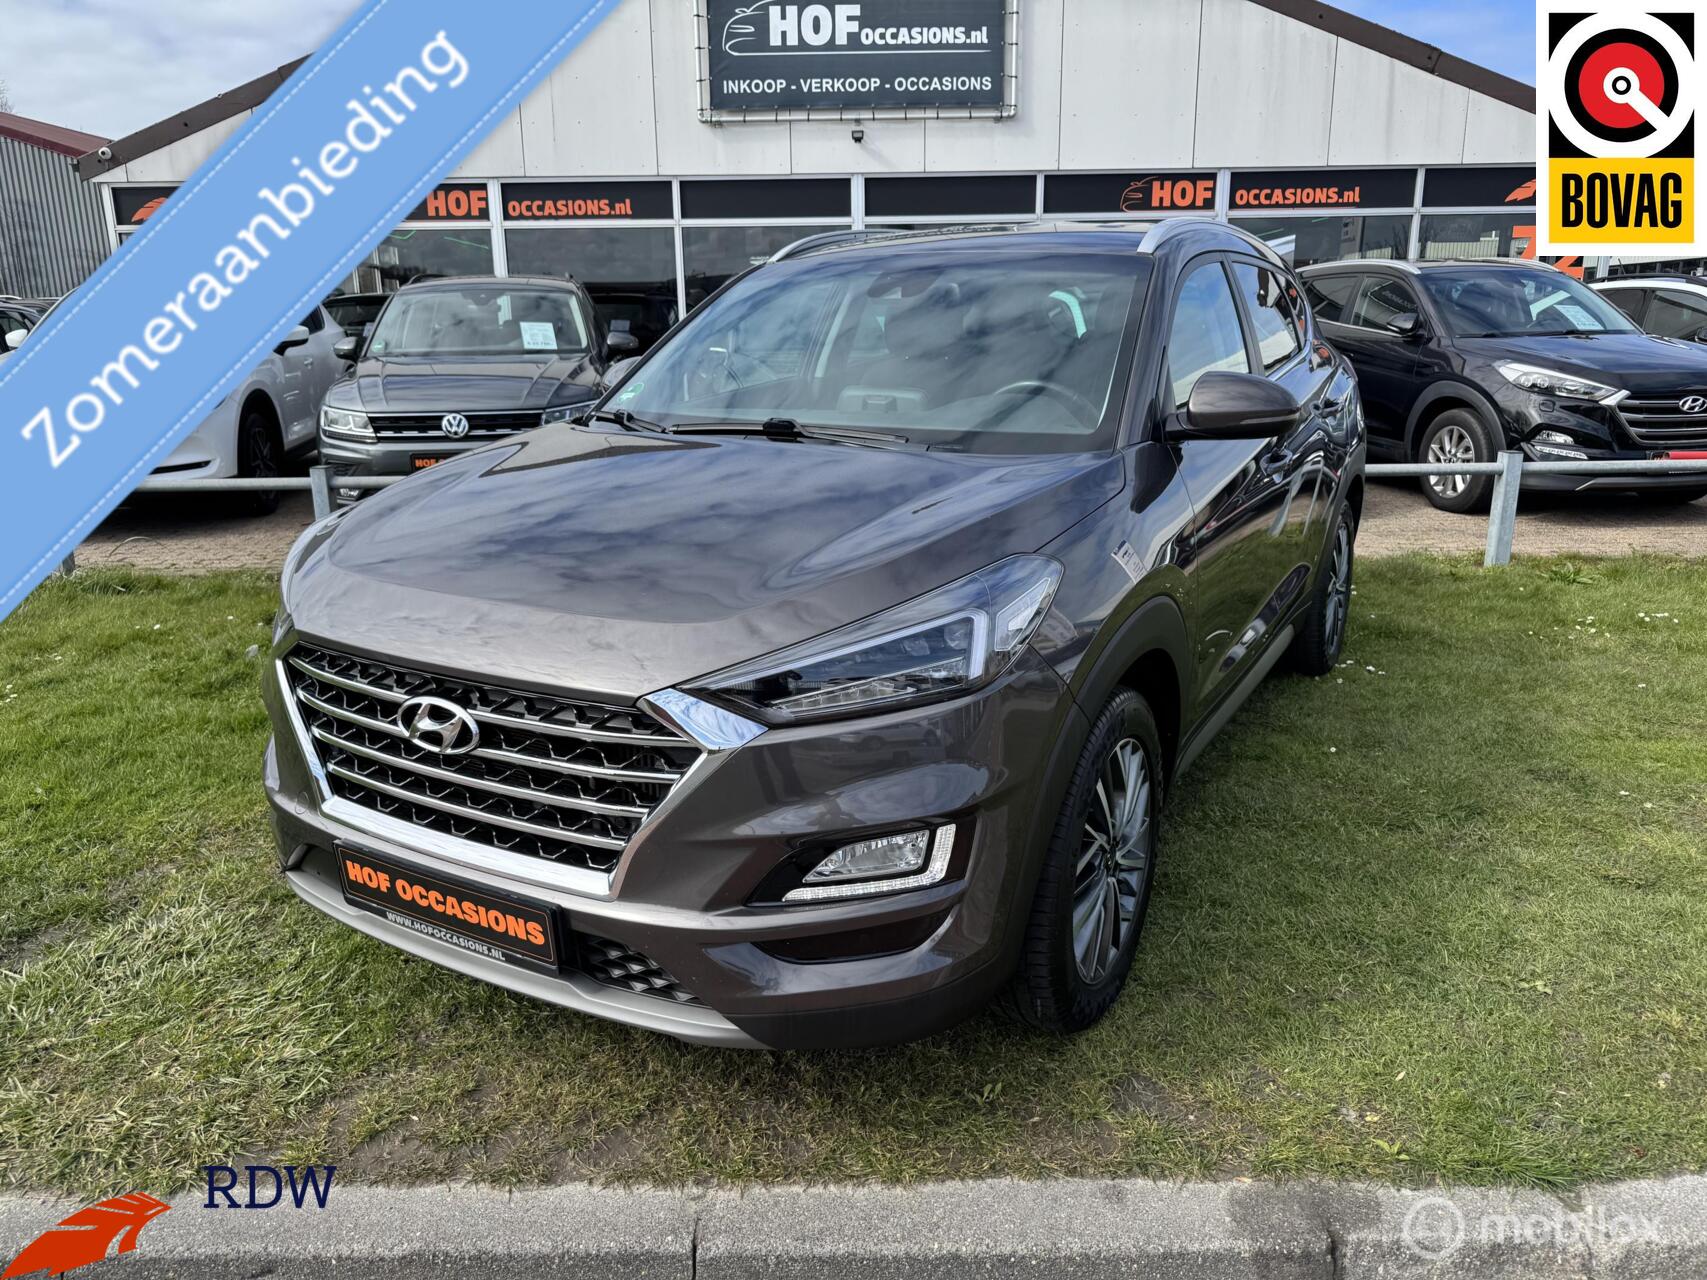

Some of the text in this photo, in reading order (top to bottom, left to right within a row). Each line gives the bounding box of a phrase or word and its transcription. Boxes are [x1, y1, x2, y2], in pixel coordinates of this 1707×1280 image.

[769, 4, 988, 46] HOF OCCASIONS.nl
[723, 79, 786, 93] INKOOP
[800, 78, 880, 92] VERKOOP
[894, 76, 992, 91] OCCASIONS
[426, 189, 632, 216] HOF OCCASIONS.nl
[1151, 180, 1360, 207] HOF OCCASIONS.nl
[346, 860, 545, 945] HOF OCCASIONS
[386, 911, 506, 961] WWW.HOFOCCASIONS.NL
